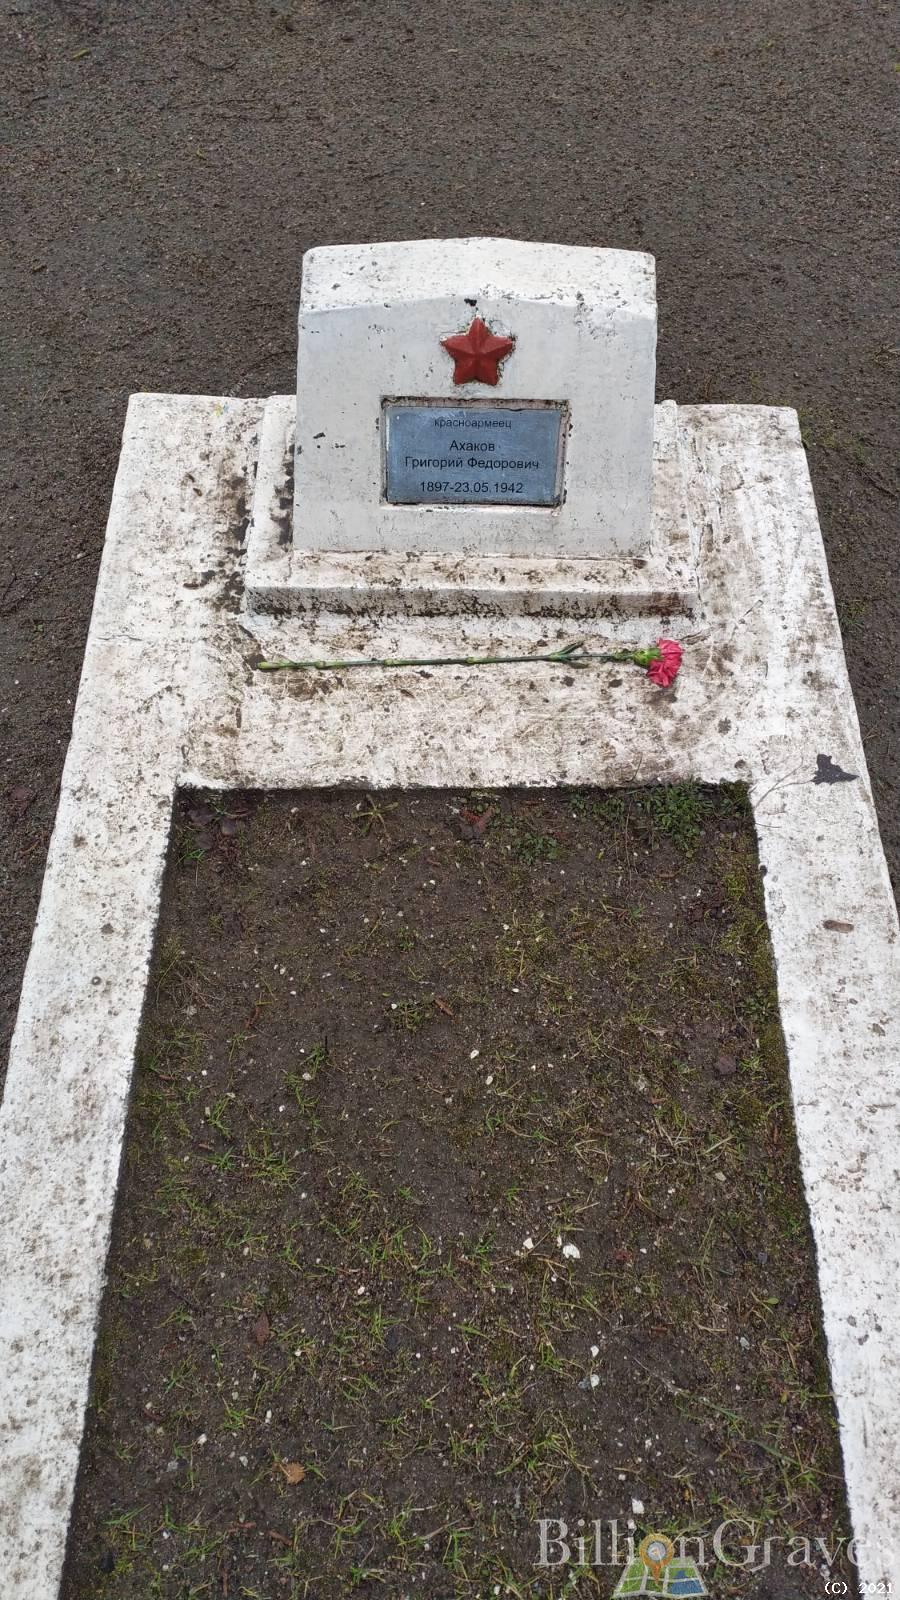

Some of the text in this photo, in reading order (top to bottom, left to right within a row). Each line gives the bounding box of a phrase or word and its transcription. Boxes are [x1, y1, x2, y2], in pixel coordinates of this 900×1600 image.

[434, 418, 512, 428] красноармеец
[449, 439, 496, 452] Ахаков
[405, 456, 539, 470] Григорий Федорович
[420, 481, 524, 494] 1897-23.05.1942
